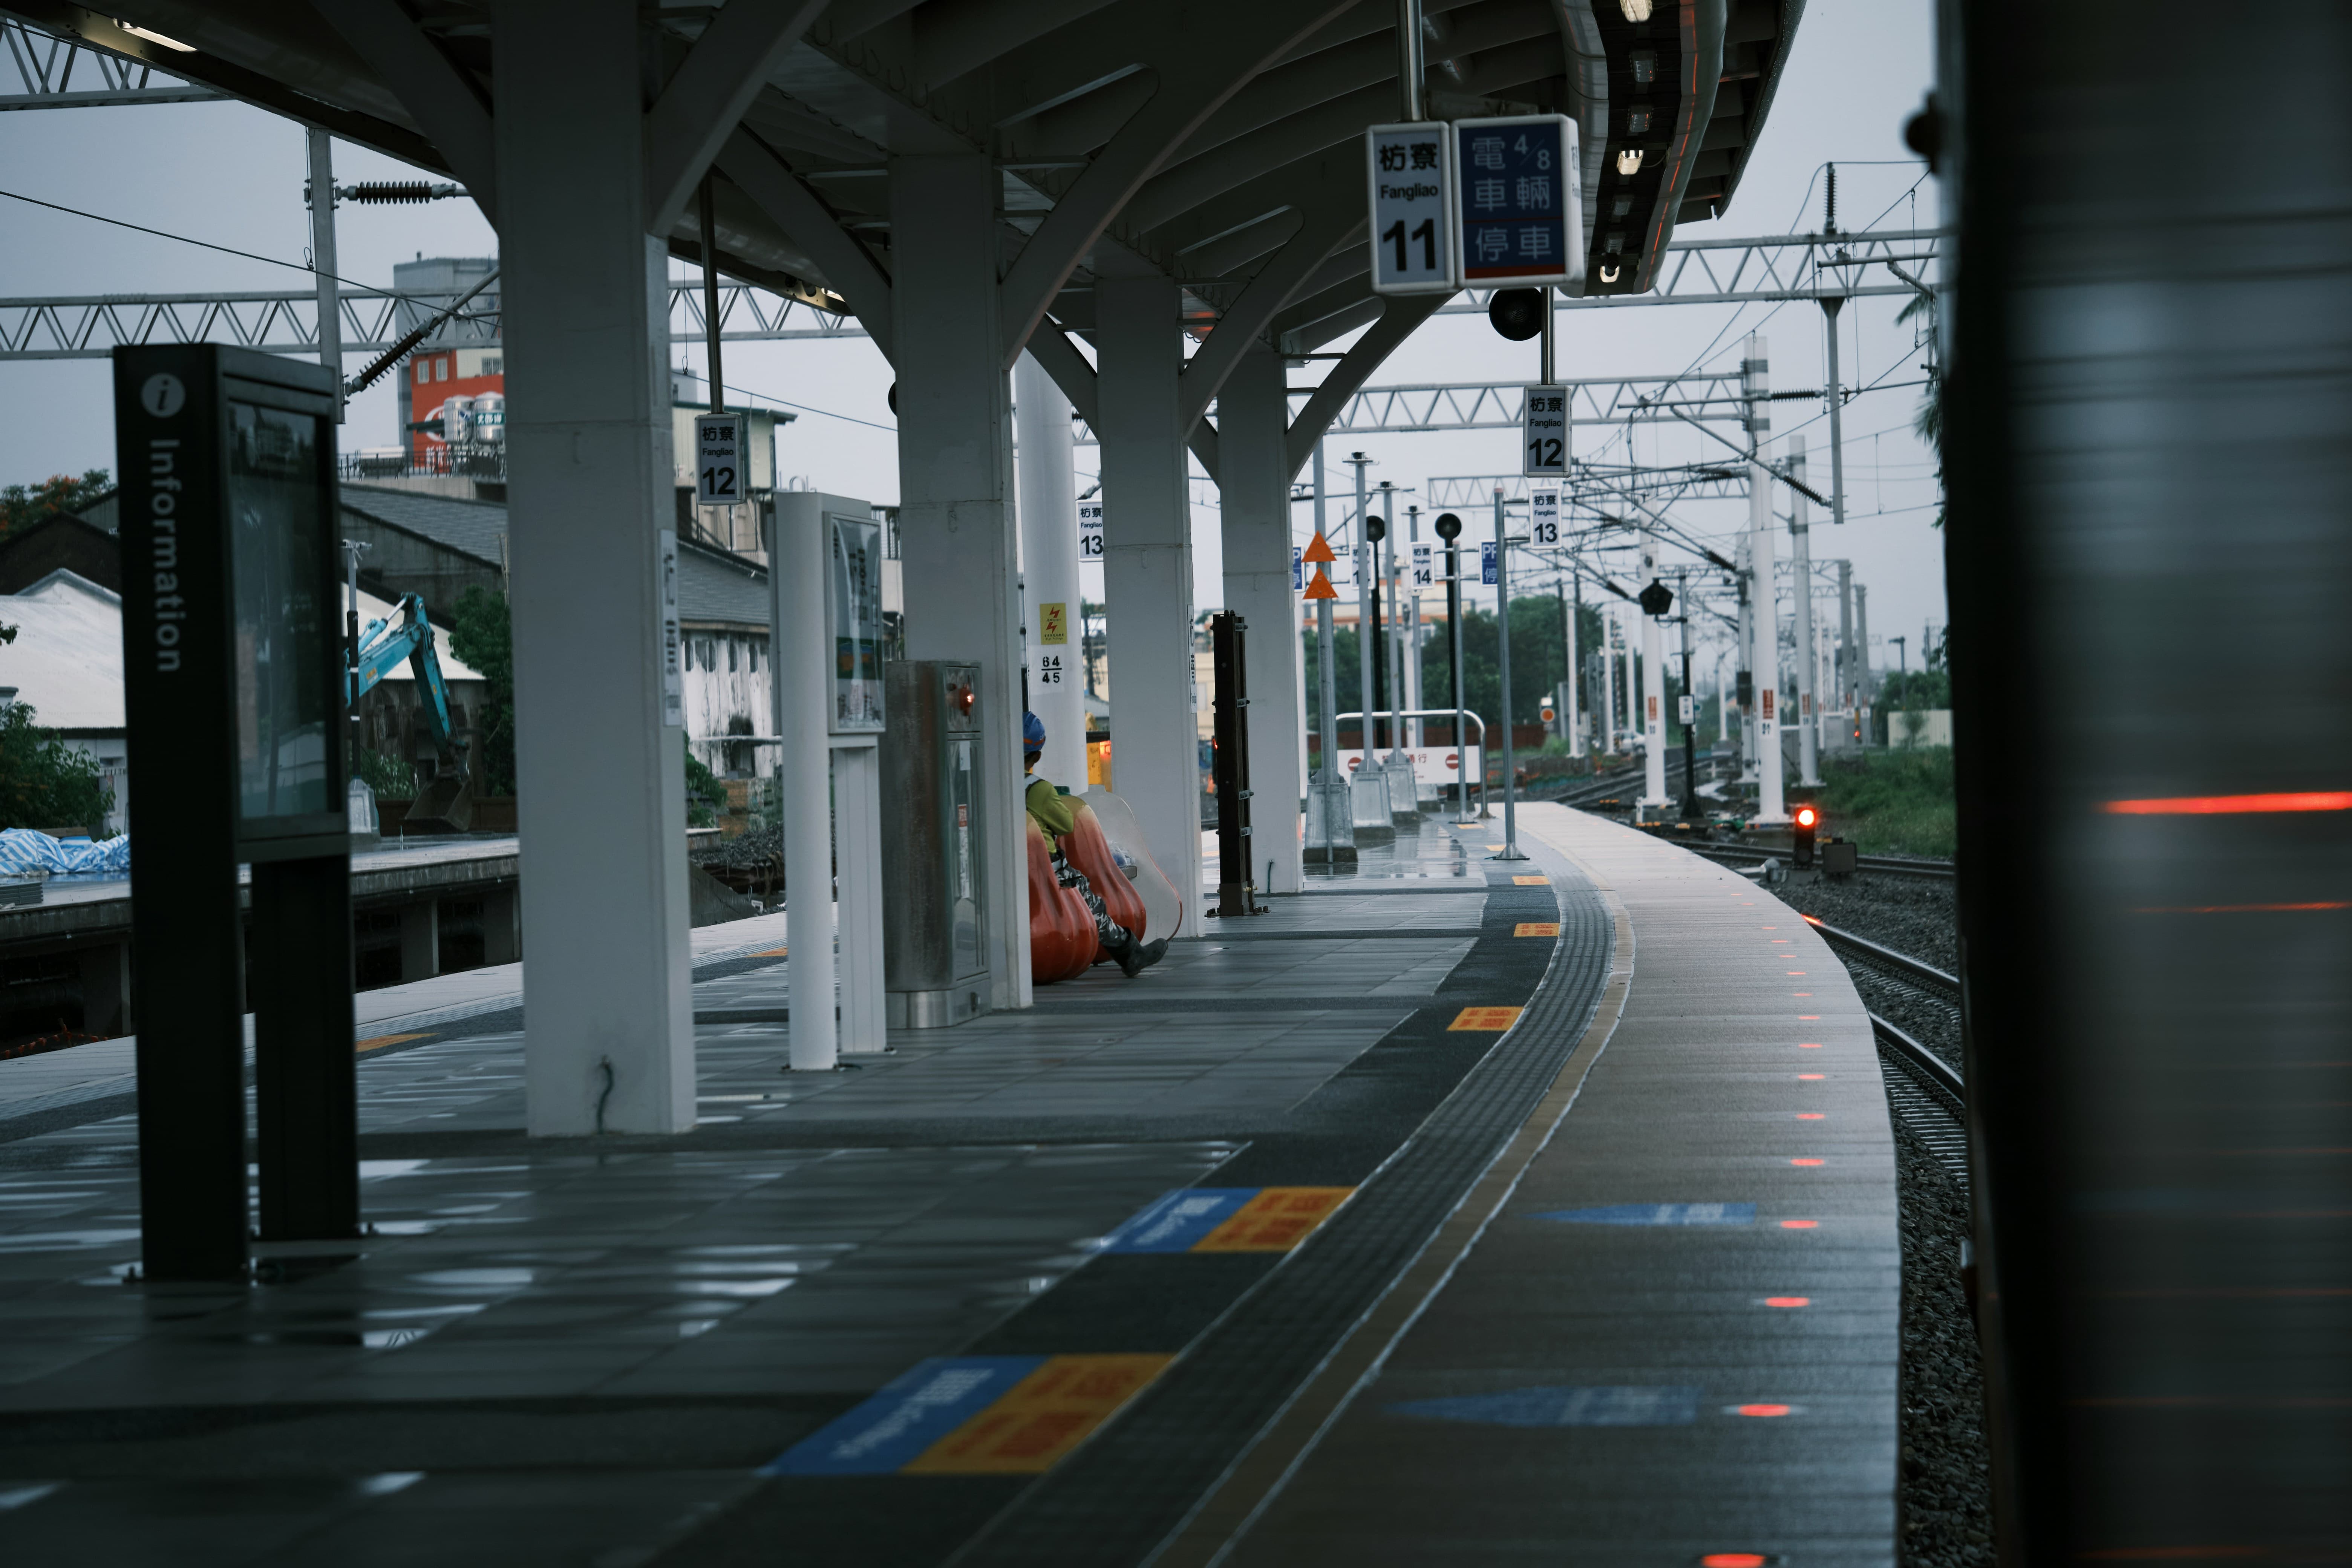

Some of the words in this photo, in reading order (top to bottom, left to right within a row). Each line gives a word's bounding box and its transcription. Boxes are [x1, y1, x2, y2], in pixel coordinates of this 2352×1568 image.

[1379, 142, 1437, 171] 枋寮
[1380, 184, 1438, 201] Fangliao
[1383, 218, 1435, 271] 11
[1476, 225, 1551, 261] 停車
[1530, 397, 1562, 412] 枋寮
[1530, 419, 1561, 428] Fangliao
[703, 427, 734, 441] 枋寮
[703, 448, 733, 457] Fangliao
[1529, 438, 1562, 466] 12
[703, 467, 735, 495] 12
[1534, 495, 1556, 505] 枋寮
[1081, 508, 1102, 518] 枋寮
[1535, 523, 1557, 542] 13
[1081, 535, 1103, 554] 13
[151, 439, 185, 672] Information
[1414, 569, 1431, 584] 14
[1043, 656, 1060, 667] 64
[1042, 672, 1060, 683] 45
